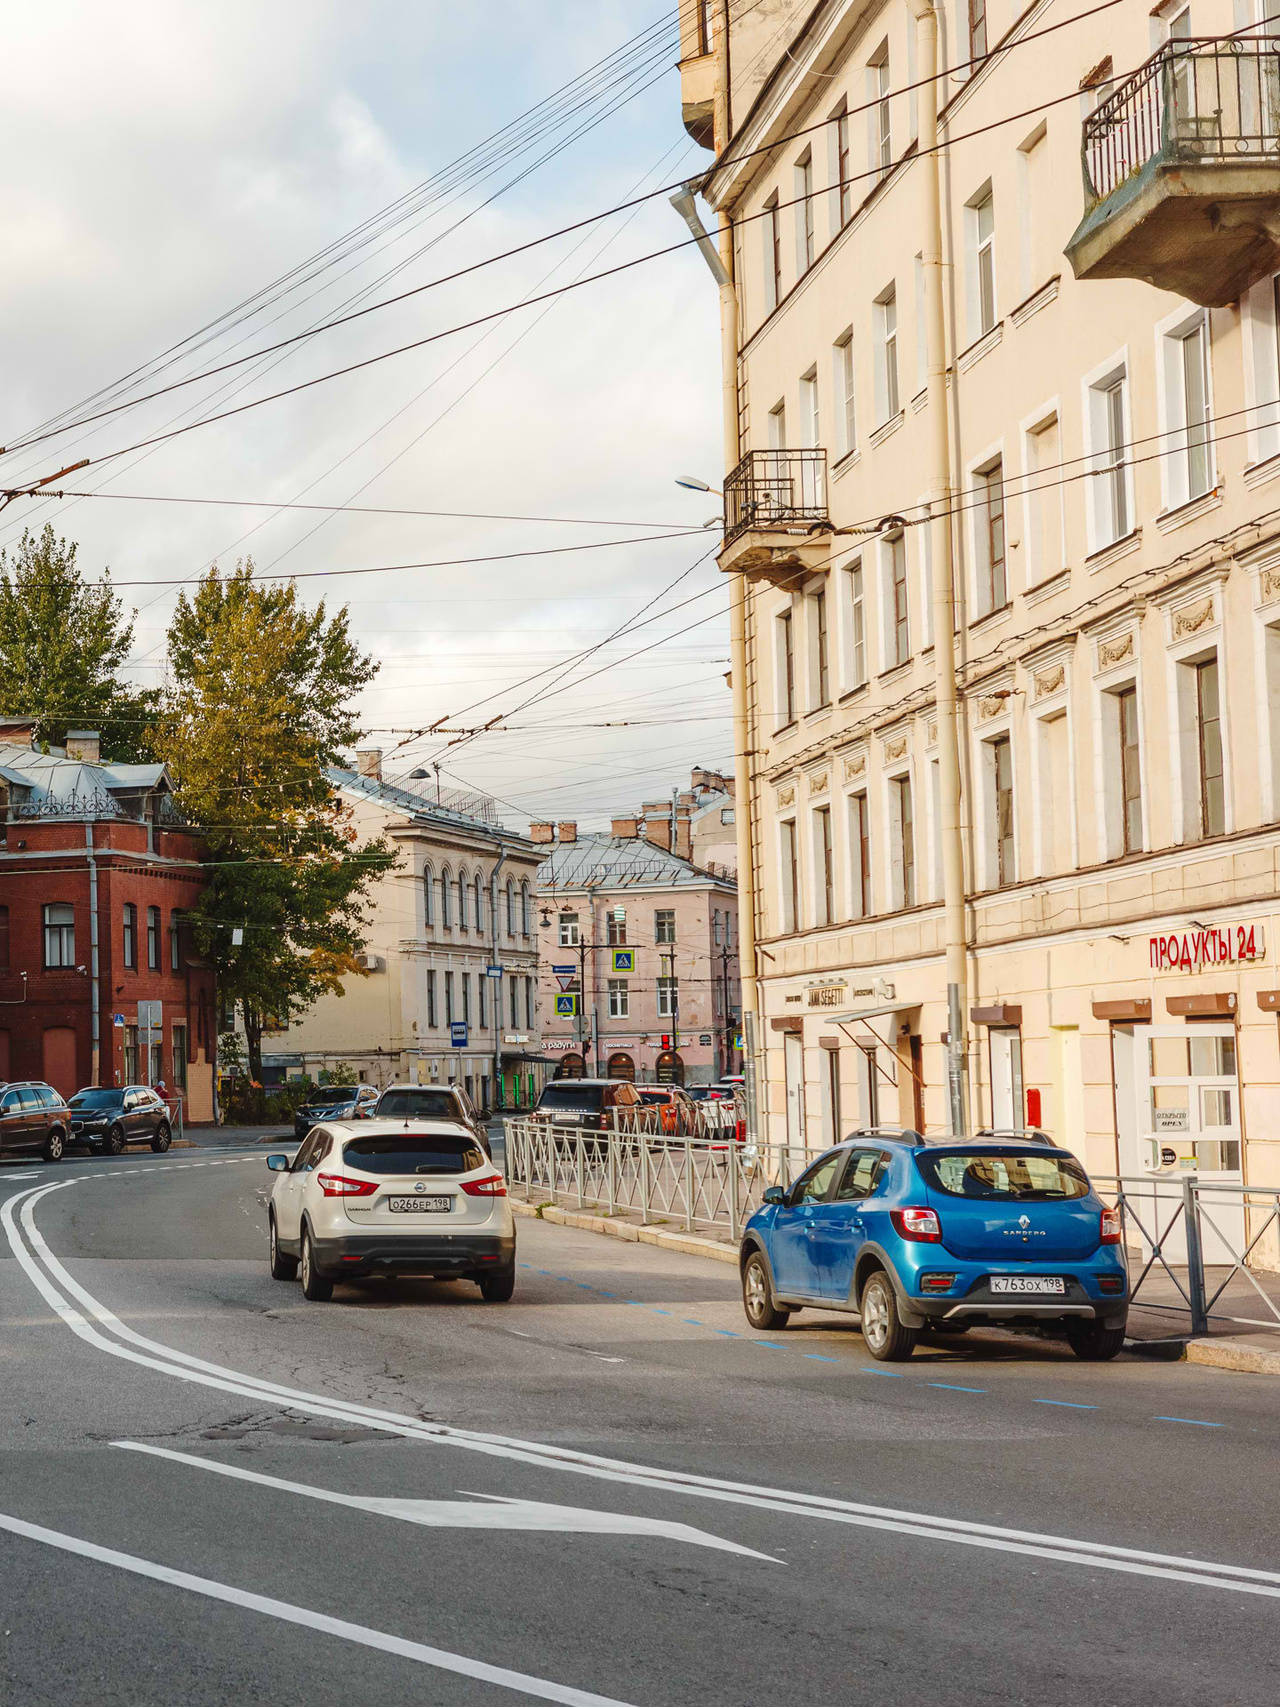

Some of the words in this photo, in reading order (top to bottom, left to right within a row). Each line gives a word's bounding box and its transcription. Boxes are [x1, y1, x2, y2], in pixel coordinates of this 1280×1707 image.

[1149, 927, 1232, 971] ПРОДУКТЫ
[1236, 924, 1256, 959] 24
[392, 1199, 432, 1209] О266ЕР
[433, 1198, 449, 1207] 198
[994, 1278, 1042, 1291] К763ОХ
[1043, 1278, 1061, 1288] 198
